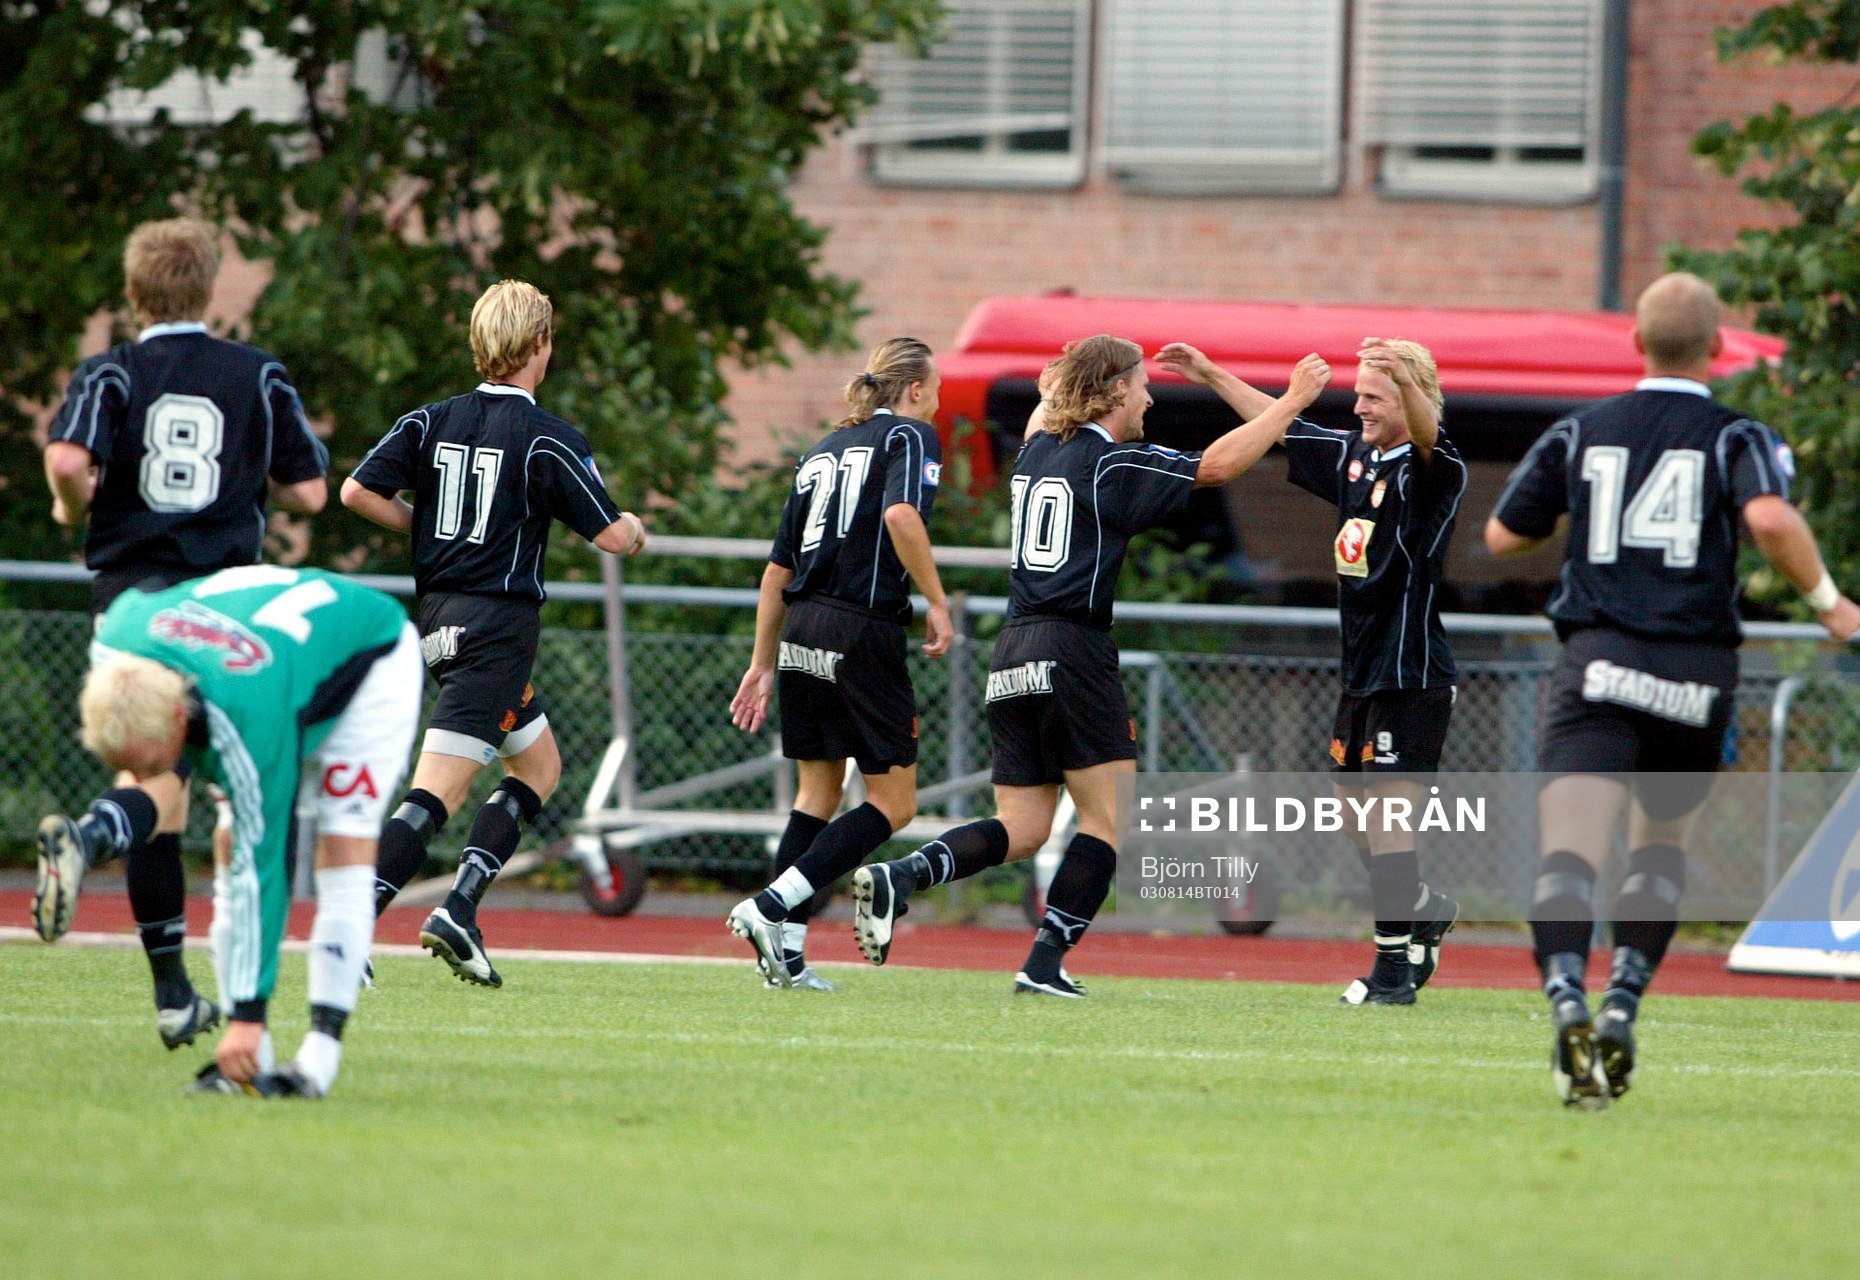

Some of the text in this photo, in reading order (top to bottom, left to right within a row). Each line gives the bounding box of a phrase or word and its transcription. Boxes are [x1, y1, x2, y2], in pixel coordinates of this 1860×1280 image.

[138, 393, 224, 513] 8
[433, 441, 504, 544] 11
[796, 446, 875, 553] 21
[1010, 474, 1074, 572] 10
[1582, 445, 1706, 568] 14
[778, 640, 838, 684] ADIUM
[1583, 659, 1713, 728] STADIUM
[1377, 731, 1392, 752] 9
